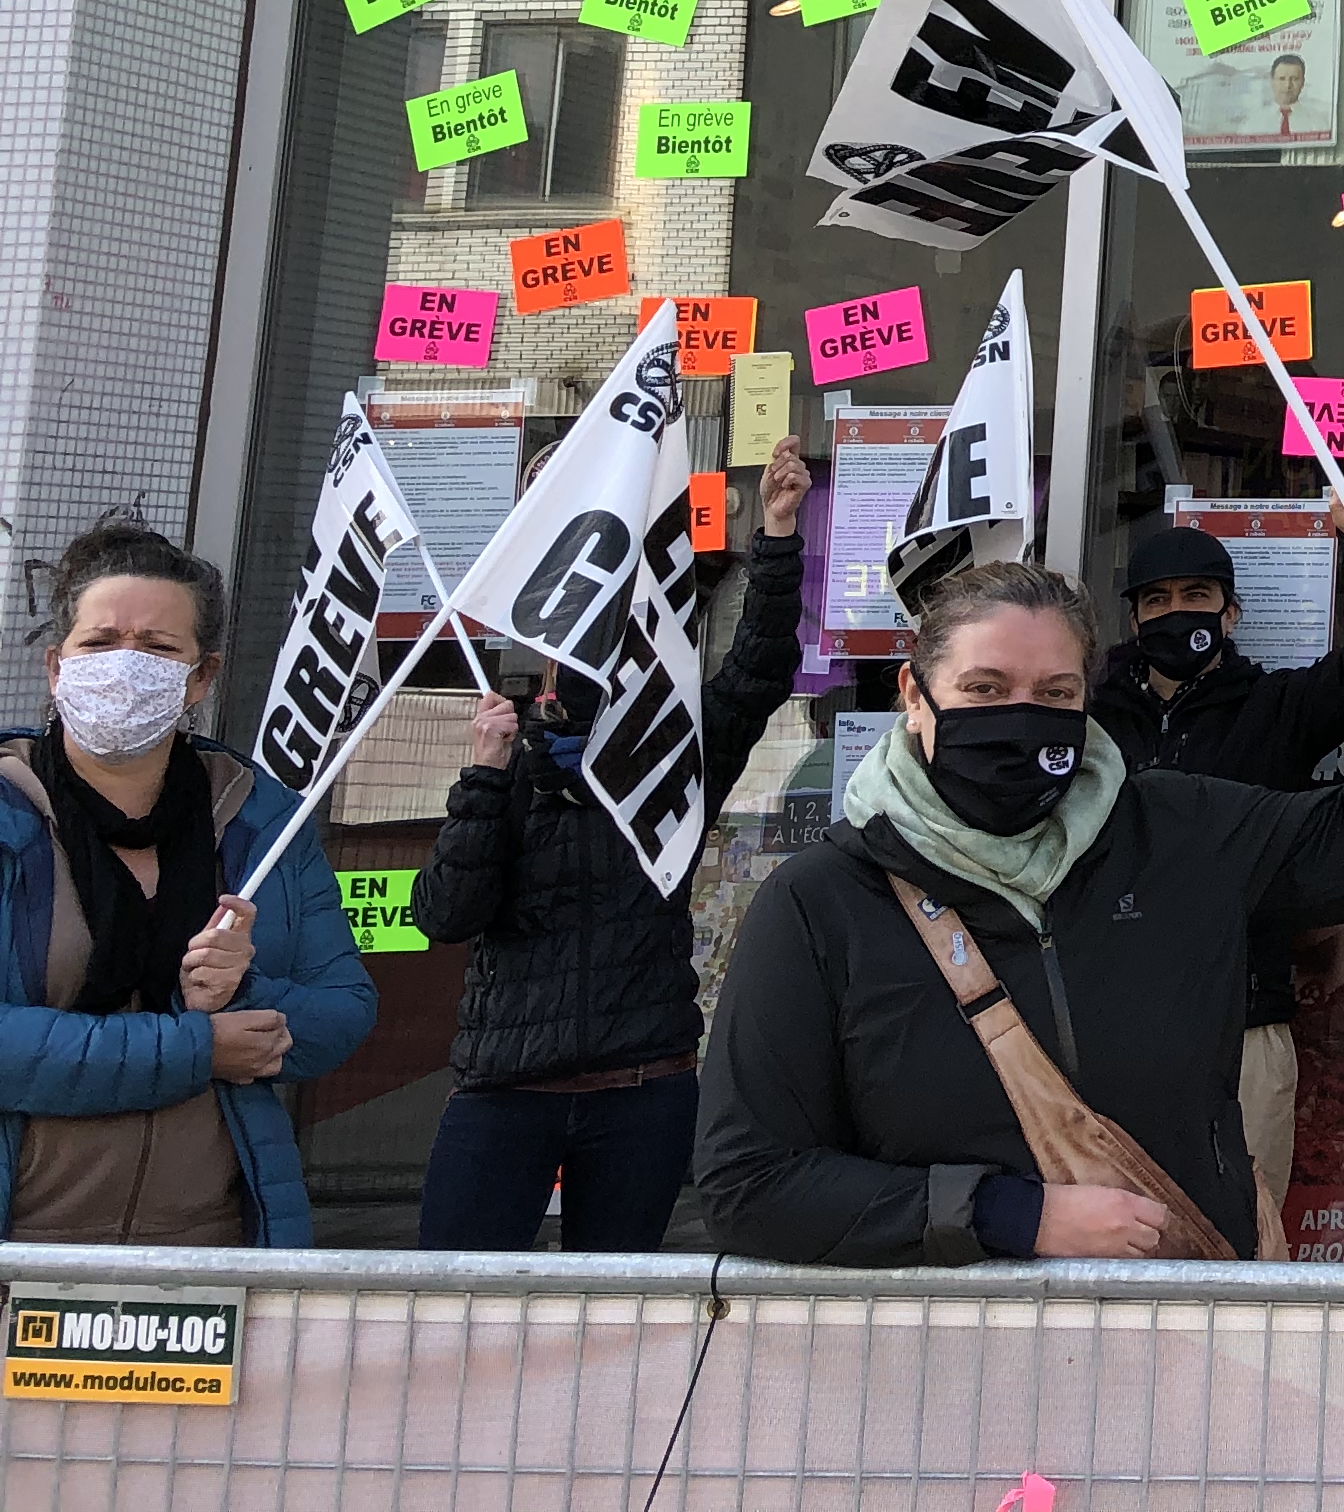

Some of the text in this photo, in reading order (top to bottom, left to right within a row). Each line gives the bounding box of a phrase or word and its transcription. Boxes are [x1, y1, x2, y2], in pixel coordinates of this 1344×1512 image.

[658, 107, 734, 132] En grève
[656, 134, 733, 155] Bientôt
[544, 233, 581, 258] EN
[521, 253, 613, 289] GRÈVE
[419, 291, 457, 314] EN
[842, 300, 880, 327] EN
[388, 315, 482, 343] GRÈVE
[819, 321, 914, 359] GRÈVE
[869, 409, 902, 419] Message
[332, 431, 374, 489] CSN
[1210, 502, 1242, 511] Message
[261, 489, 404, 794] GRÈVE
[1048, 759, 1070, 772] CSN
[772, 825, 784, 846] À
[61, 1311, 227, 1355] MODU-LOC
[12, 1369, 222, 1394] www.moduloc.ca
